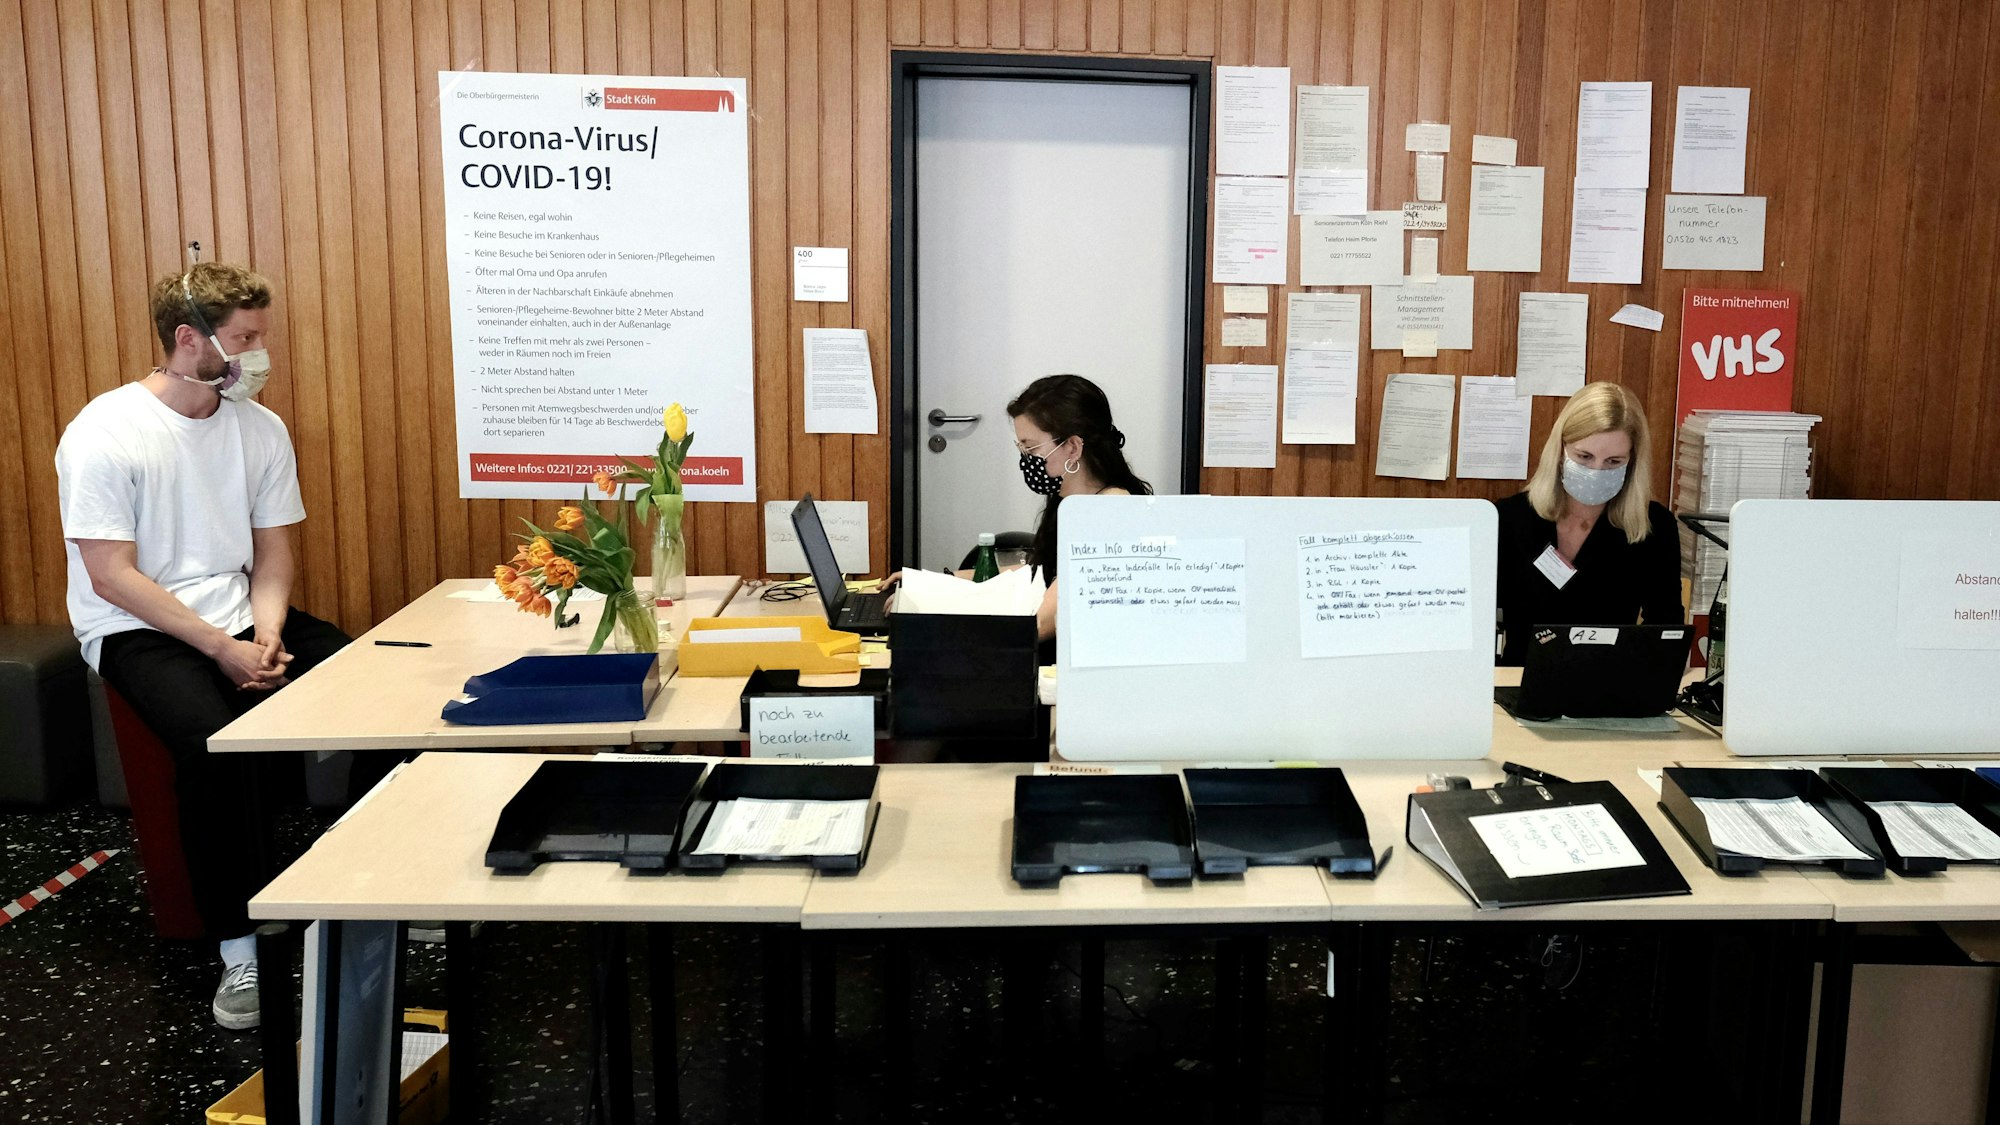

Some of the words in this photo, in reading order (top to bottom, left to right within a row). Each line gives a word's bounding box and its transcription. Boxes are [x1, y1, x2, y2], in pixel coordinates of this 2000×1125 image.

[469, 91, 540, 101] Oberbürgermeisterin
[606, 94, 632, 104] Stadt
[634, 94, 656, 105] Köln
[458, 123, 659, 160] Corona-Virus/
[461, 163, 612, 191] COVID-19!
[1669, 204, 1699, 213] Unsere
[1705, 204, 1748, 214] Telefon-
[473, 211, 497, 220] Keine
[498, 211, 527, 222] Reisen,
[528, 212, 546, 223] egal
[547, 212, 573, 222] wohin
[474, 230, 497, 239] Keine
[498, 230, 533, 240] Besuche
[534, 231, 546, 240] im
[546, 231, 600, 241] Krankenhaus
[474, 249, 498, 258] Keine
[499, 249, 534, 258] Besuche
[534, 249, 548, 259] bei
[549, 250, 586, 259] Senioren
[587, 250, 607, 260] oder
[608, 251, 616, 260] in
[617, 251, 715, 263] Senioren-/Pflegeheimen
[474, 265, 498, 276] Öfter
[499, 268, 515, 277] mal
[516, 268, 537, 277] Oma
[538, 268, 555, 278] und
[556, 269, 574, 279] Opa
[575, 269, 608, 278] anrufen
[475, 284, 506, 295] Älteren
[507, 286, 516, 295] in
[517, 286, 531, 296] der
[532, 287, 592, 297] Nachbarschaft
[593, 288, 628, 298] Einkäufe
[629, 288, 674, 298] abnehmen
[1693, 295, 1719, 307] Bitte
[1722, 296, 1789, 309] mitnehmen!
[476, 304, 614, 317] Senioren-/Pflegeheime-Bewohner
[615, 307, 635, 316] bitte
[636, 307, 642, 316] 2
[644, 308, 669, 317] Meter
[670, 308, 704, 317] Abstand
[477, 317, 528, 326] voneinander
[529, 318, 570, 328] einhalten,
[571, 318, 592, 328] auch
[593, 319, 601, 328] in
[602, 319, 617, 328] der
[618, 319, 672, 331] Außenanlage
[478, 336, 501, 345] Keine
[502, 335, 532, 345] Treffen
[533, 337, 548, 345] mit
[549, 336, 572, 346] mehr
[573, 337, 584, 346] als
[585, 338, 605, 346] zwei
[606, 338, 644, 347] Personen
[478, 348, 505, 357] weder
[506, 349, 515, 357] in
[516, 348, 550, 358] Räumen
[551, 349, 573, 358] noch
[586, 350, 611, 359] Freien
[1691, 328, 1785, 380] VHS
[480, 366, 486, 375] 2
[487, 367, 512, 376] Meter
[513, 367, 548, 376] Abstand
[549, 367, 575, 377] halten
[480, 384, 503, 394] Nicht
[504, 385, 542, 396] sprechen
[543, 385, 556, 394] bei
[557, 386, 592, 395] Abstand
[593, 388, 615, 396] unter
[617, 387, 621, 395] 1
[624, 387, 649, 396] Meter
[482, 403, 520, 412] Personen
[521, 404, 536, 412] mit
[537, 404, 634, 415] Atemwegsbeschwerden
[482, 415, 516, 424] zuhause
[517, 415, 548, 425] bleiben
[548, 416, 561, 425] für
[563, 416, 572, 425] 14
[574, 416, 593, 428] Tage
[594, 417, 605, 426] ab
[483, 427, 501, 436] dort
[502, 428, 545, 438] separieren
[476, 463, 516, 472] Weitere
[518, 464, 544, 474] Infos:
[546, 464, 574, 476] 0221/
[1298, 536, 1315, 545] Fall
[1322, 534, 1357, 545] komplett
[1071, 543, 1097, 555] Index
[1105, 542, 1122, 555] Info
[1132, 542, 1167, 556] erledigt
[1354, 551, 1387, 560] komplette
[1166, 562, 1181, 571] Info
[1088, 573, 1132, 582] Laborbefund
[759, 706, 795, 721] noch
[803, 710, 824, 719] zu
[759, 730, 852, 744] bearbeitende
